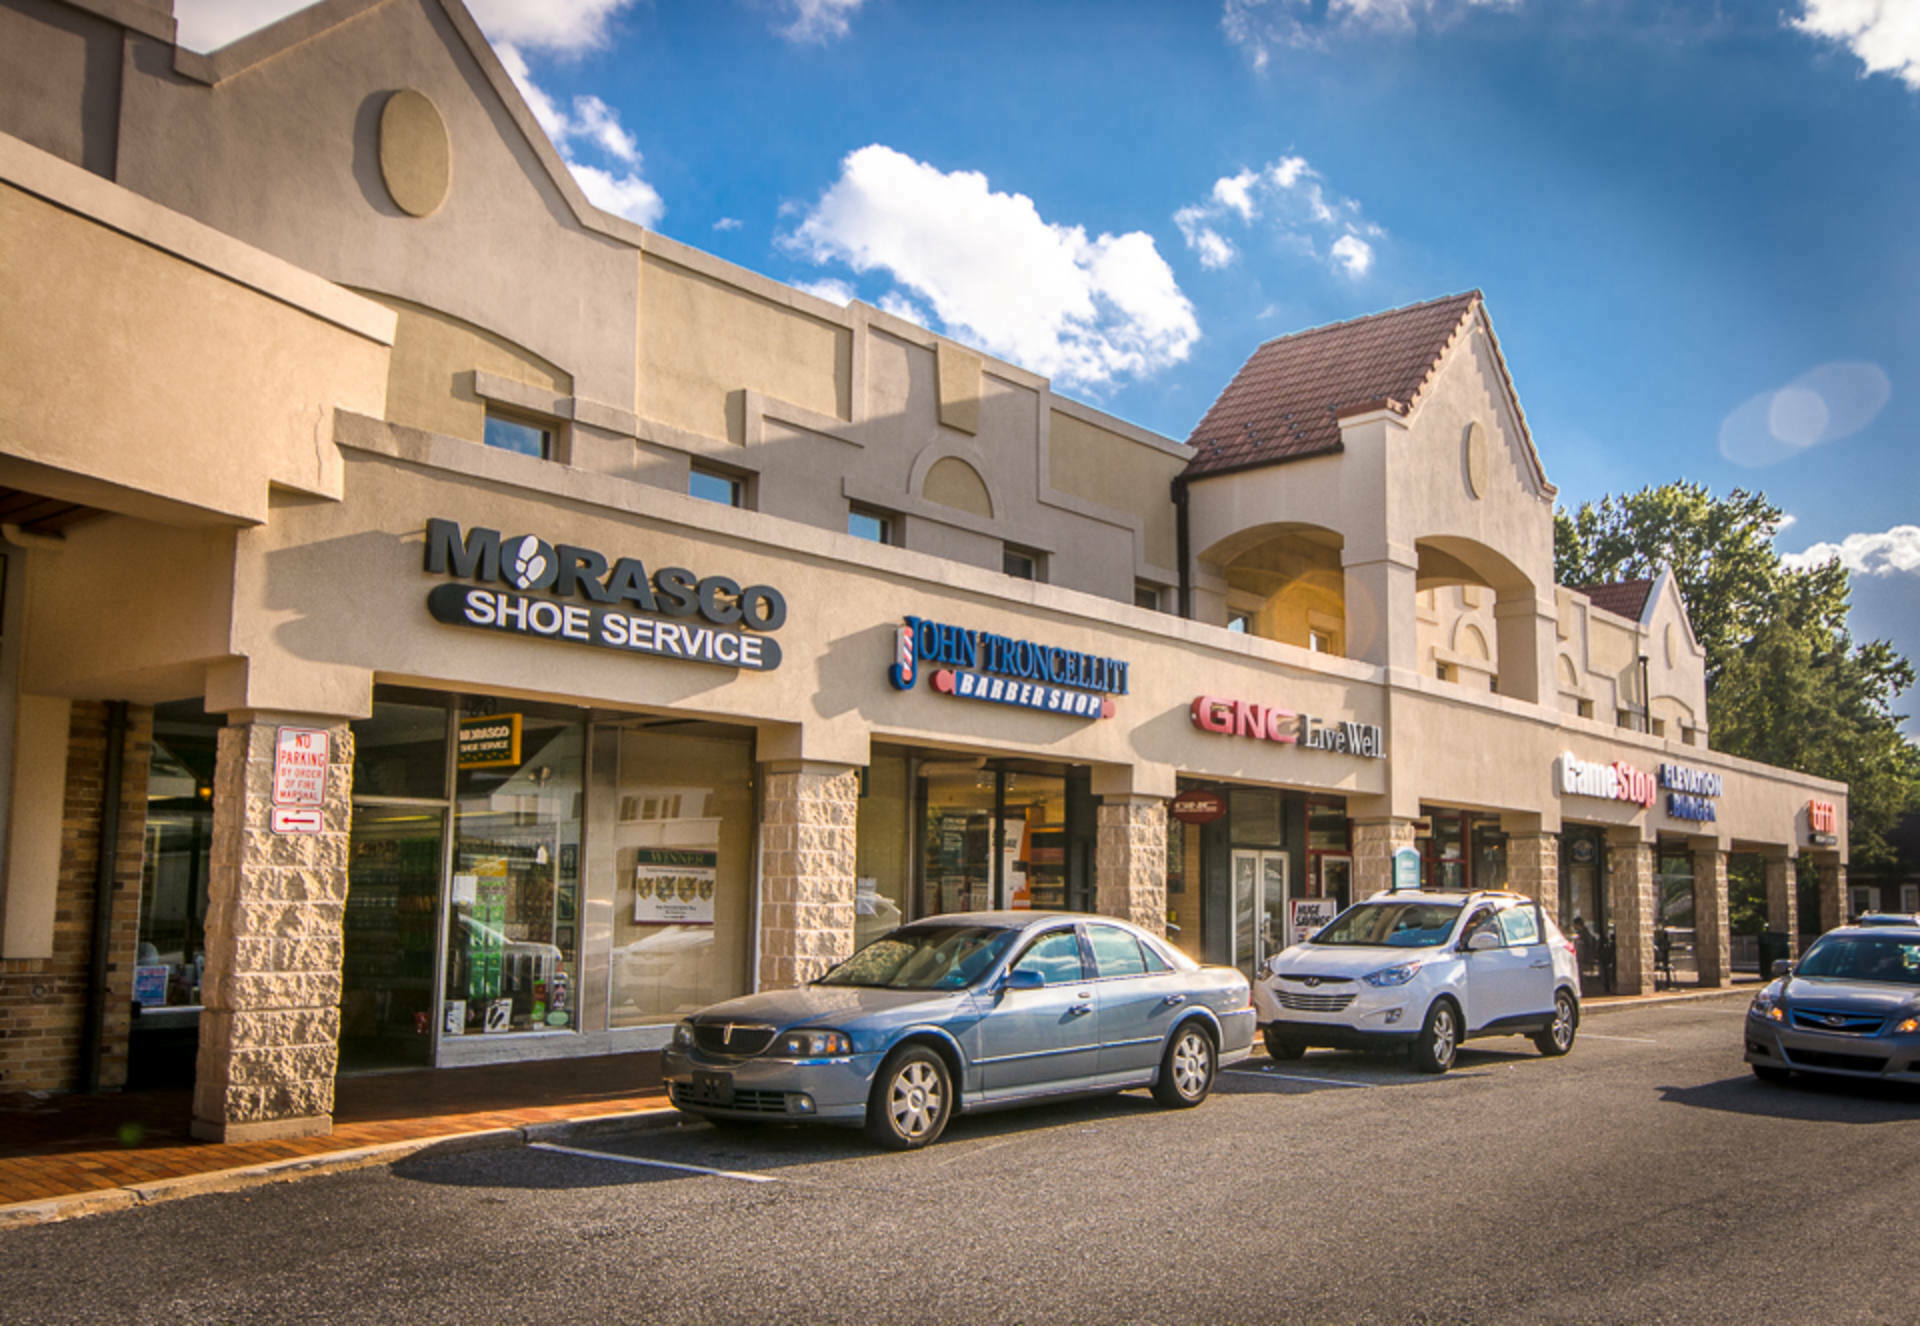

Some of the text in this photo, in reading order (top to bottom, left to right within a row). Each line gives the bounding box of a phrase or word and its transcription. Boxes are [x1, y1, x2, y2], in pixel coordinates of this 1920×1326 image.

[424, 517, 788, 631] MORASCO
[464, 589, 763, 667] SHOE SERVICE
[889, 615, 1130, 695] JOHN TRONCELLITI
[960, 673, 1100, 716] BARBER SHOP
[1191, 695, 1297, 744] GNC
[1299, 713, 1345, 753] Live
[280, 750, 324, 768] PARKING
[296, 734, 311, 749] NO
[281, 767, 322, 779] BY ORDER
[285, 779, 316, 791] OF FIRE
[1562, 751, 1657, 808] GameStop
[1660, 763, 1723, 797] ELEVATION
[279, 790, 318, 800] MARSHAL
[1667, 793, 1716, 822] BURGER
